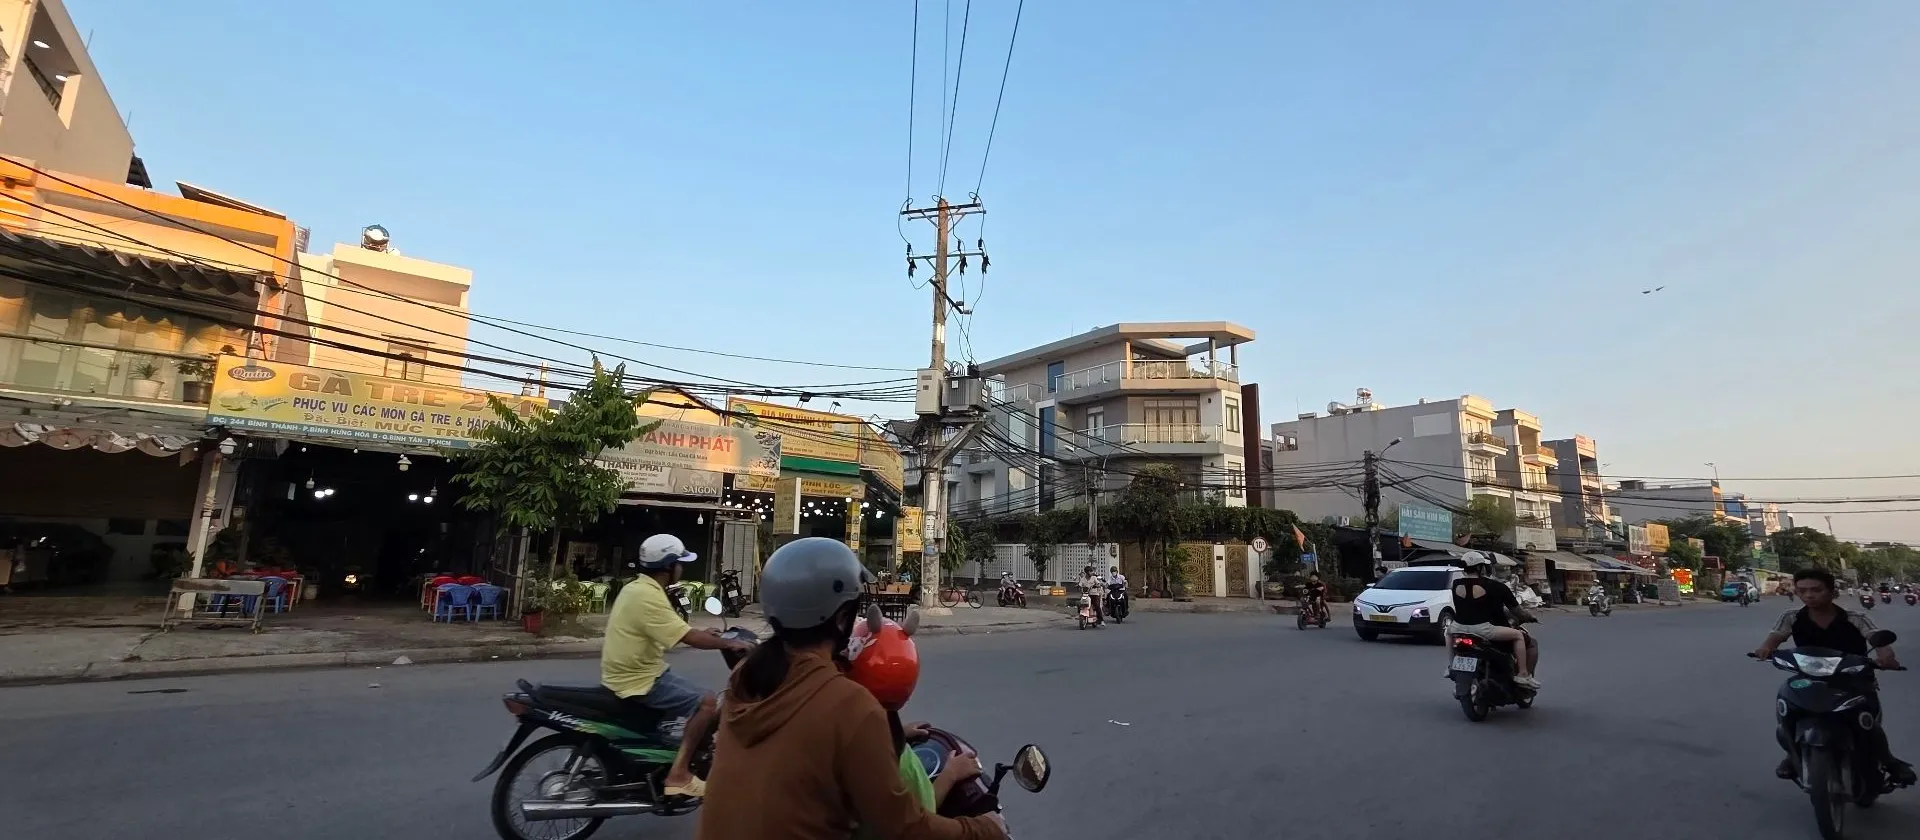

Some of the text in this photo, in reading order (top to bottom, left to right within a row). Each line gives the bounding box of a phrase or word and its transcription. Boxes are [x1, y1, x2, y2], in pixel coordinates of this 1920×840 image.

[288, 372, 352, 396] GÀ
[365, 381, 447, 408] TRE
[293, 397, 327, 411] PHỤC
[332, 401, 348, 416] VỤ
[353, 403, 376, 417] CÁC
[430, 413, 451, 425] TRE
[455, 416, 463, 427] &
[230, 418, 245, 426] 244
[689, 434, 734, 452] PHÁT
[682, 484, 717, 495] SAIGON
